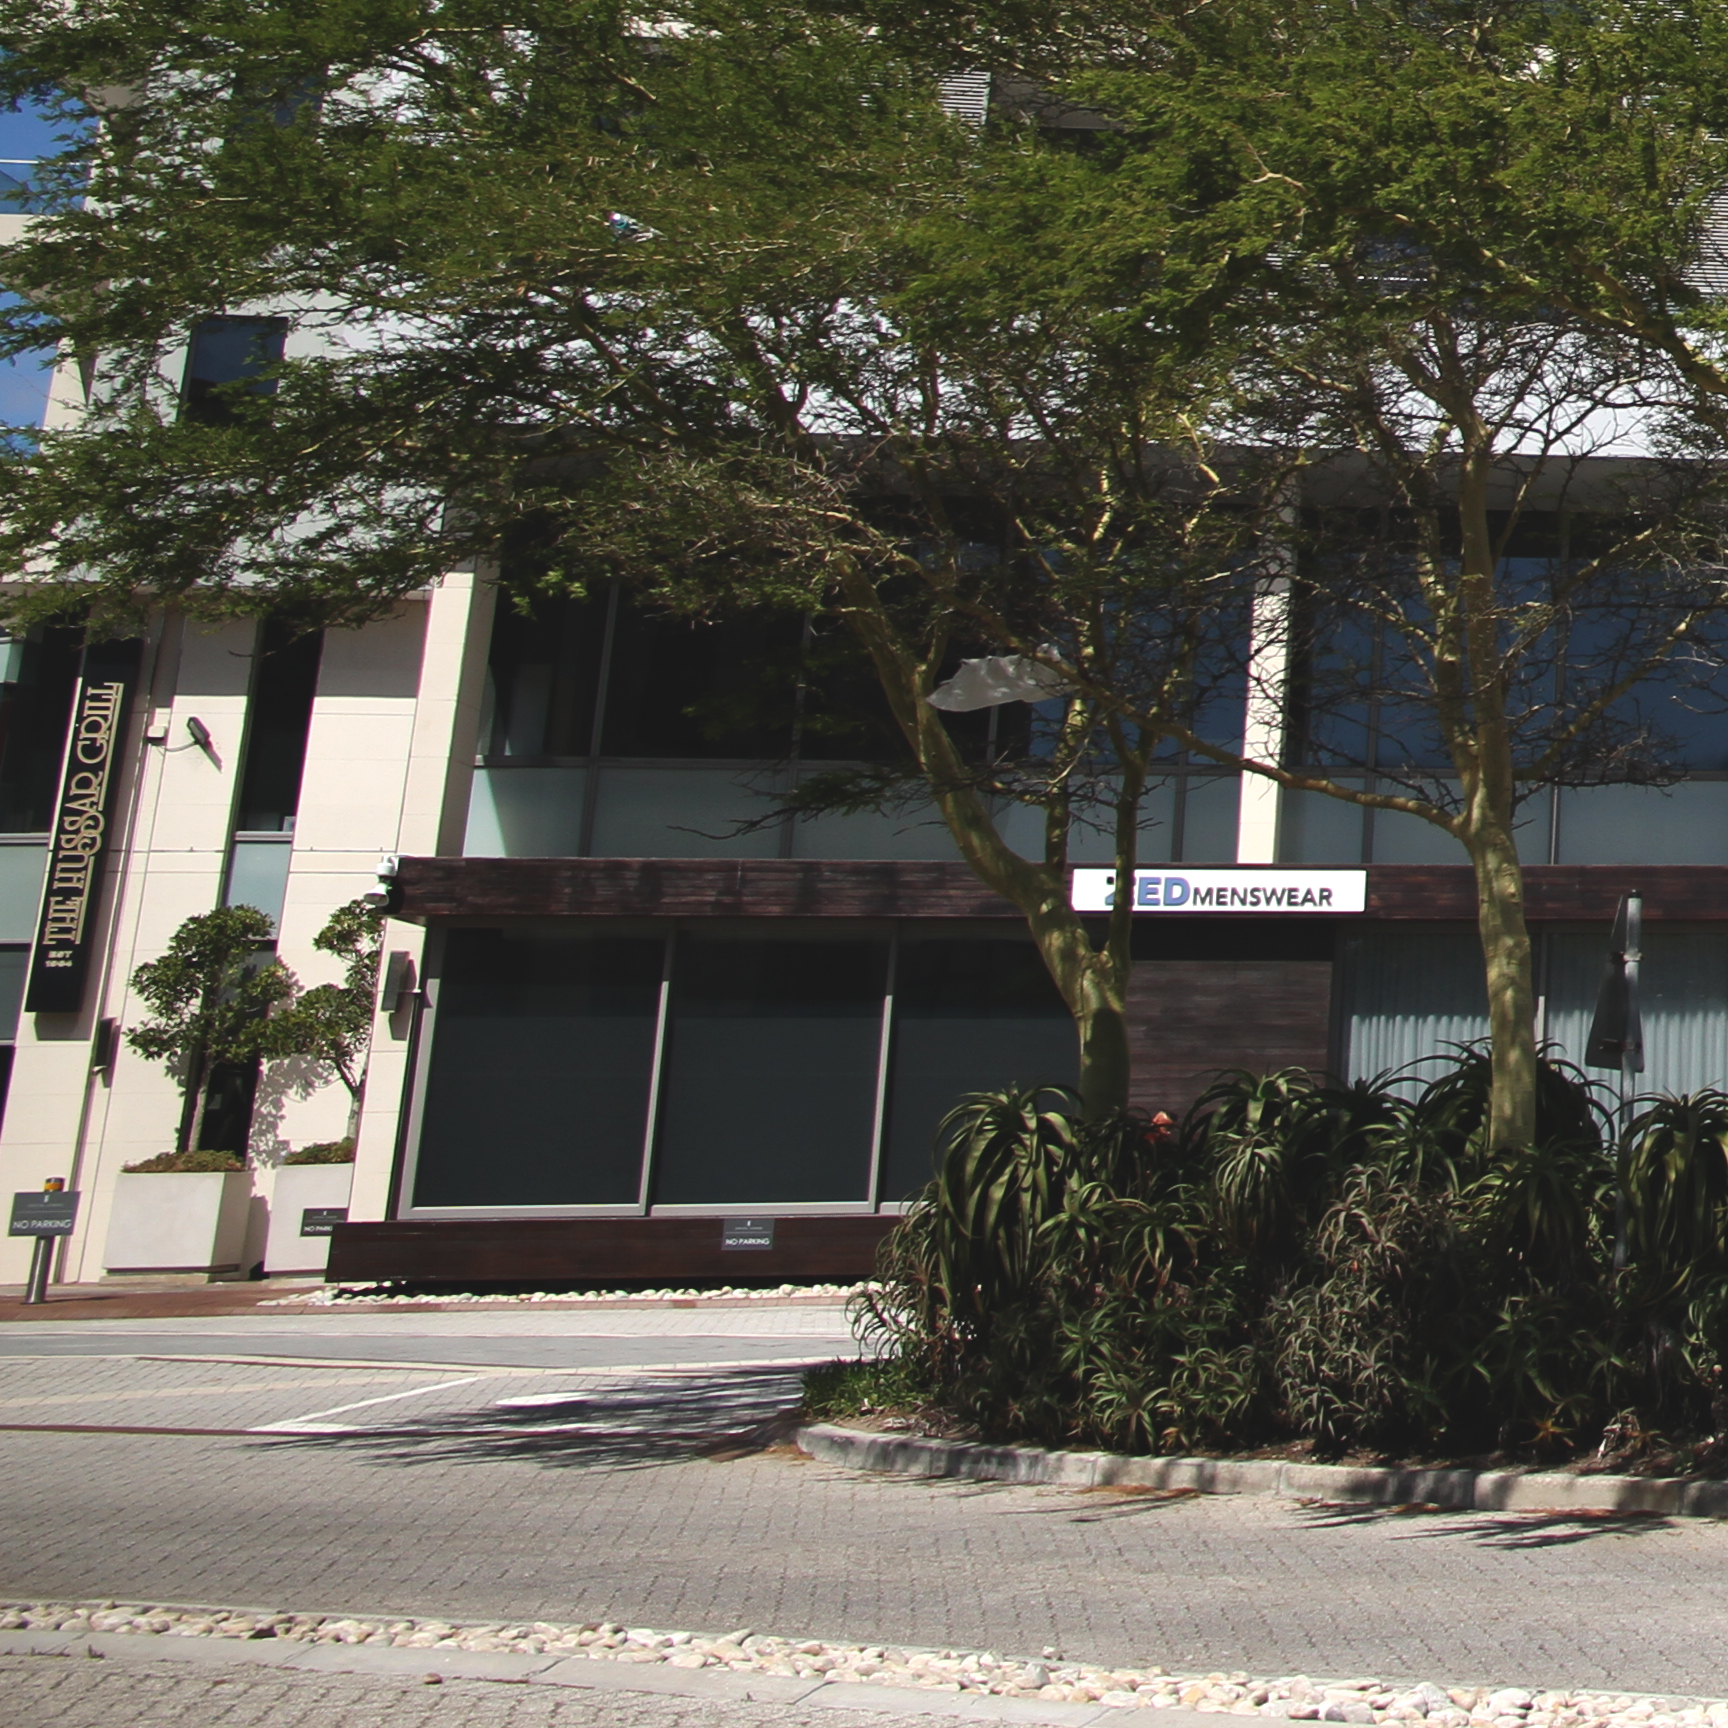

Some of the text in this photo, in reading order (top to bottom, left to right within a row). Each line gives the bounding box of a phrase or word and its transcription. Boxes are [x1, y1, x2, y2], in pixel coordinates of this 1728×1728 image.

[43, 682, 121, 945] THE HUSSAR GRILL
[1192, 886, 1334, 907] MENSWEAR
[12, 1218, 72, 1229] NO PARKING
[725, 1237, 770, 1245] NO PARKING
